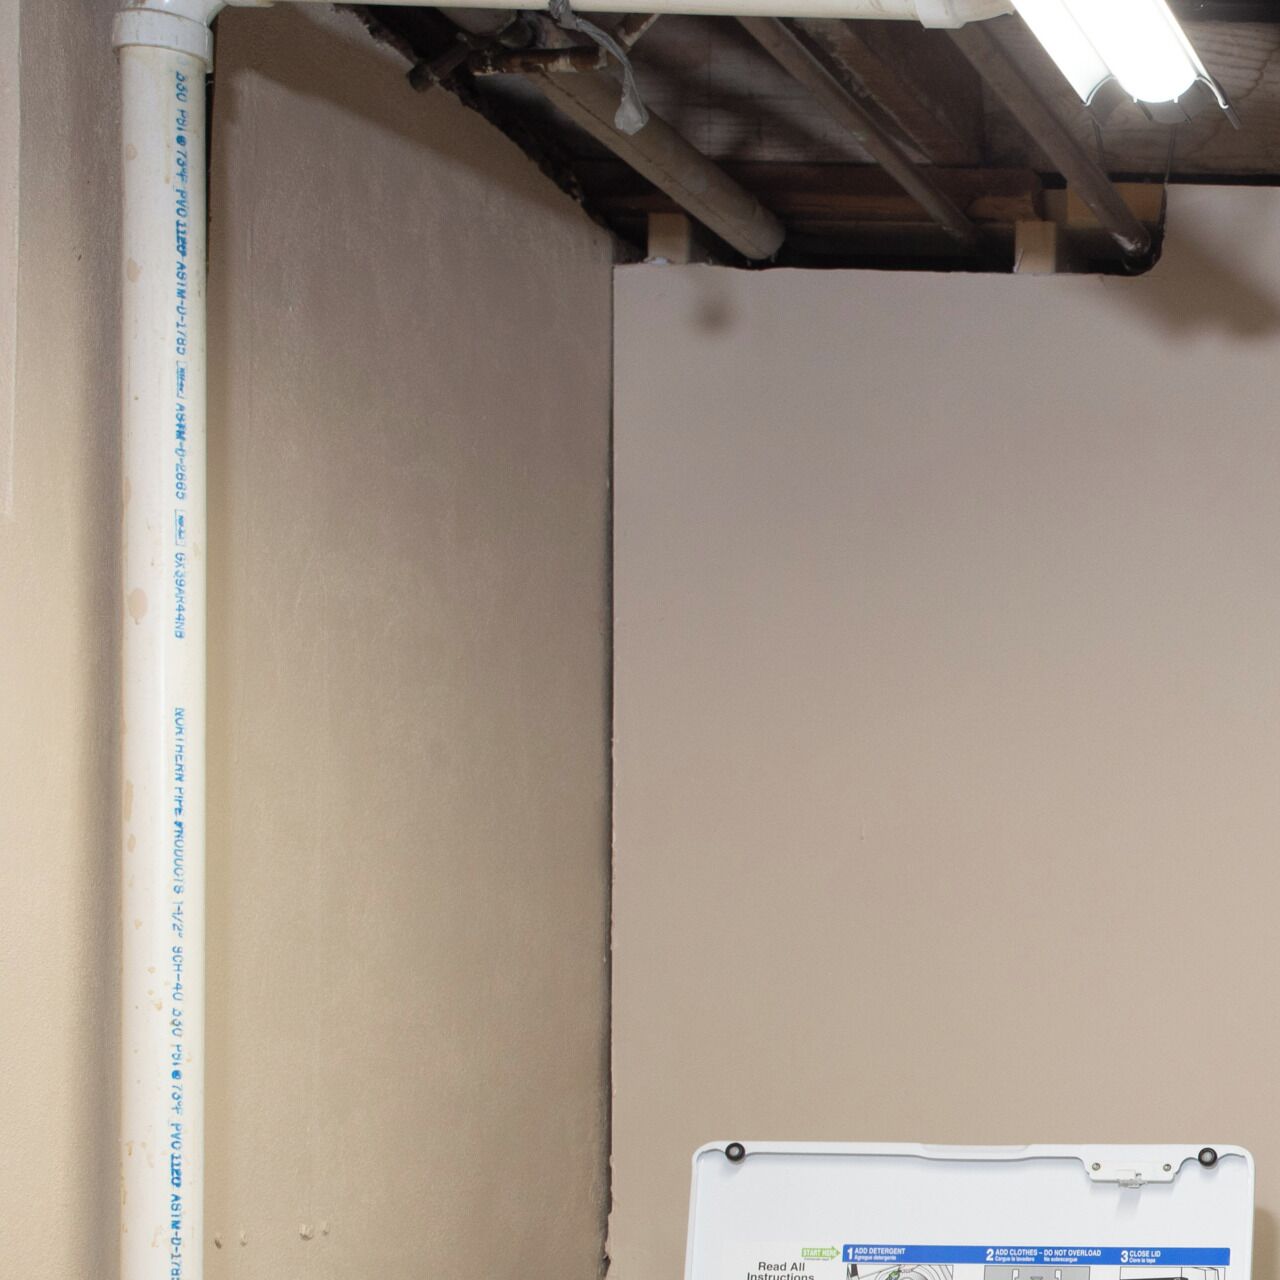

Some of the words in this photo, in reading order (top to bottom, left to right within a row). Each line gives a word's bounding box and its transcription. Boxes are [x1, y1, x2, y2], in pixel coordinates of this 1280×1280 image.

[847, 1247, 853, 1260] 1
[868, 1247, 906, 1255] DETERGENT
[985, 1248, 994, 1262] 2
[1120, 1250, 1129, 1263] 3
[758, 1261, 787, 1271] Read
[790, 1262, 805, 1272] All
